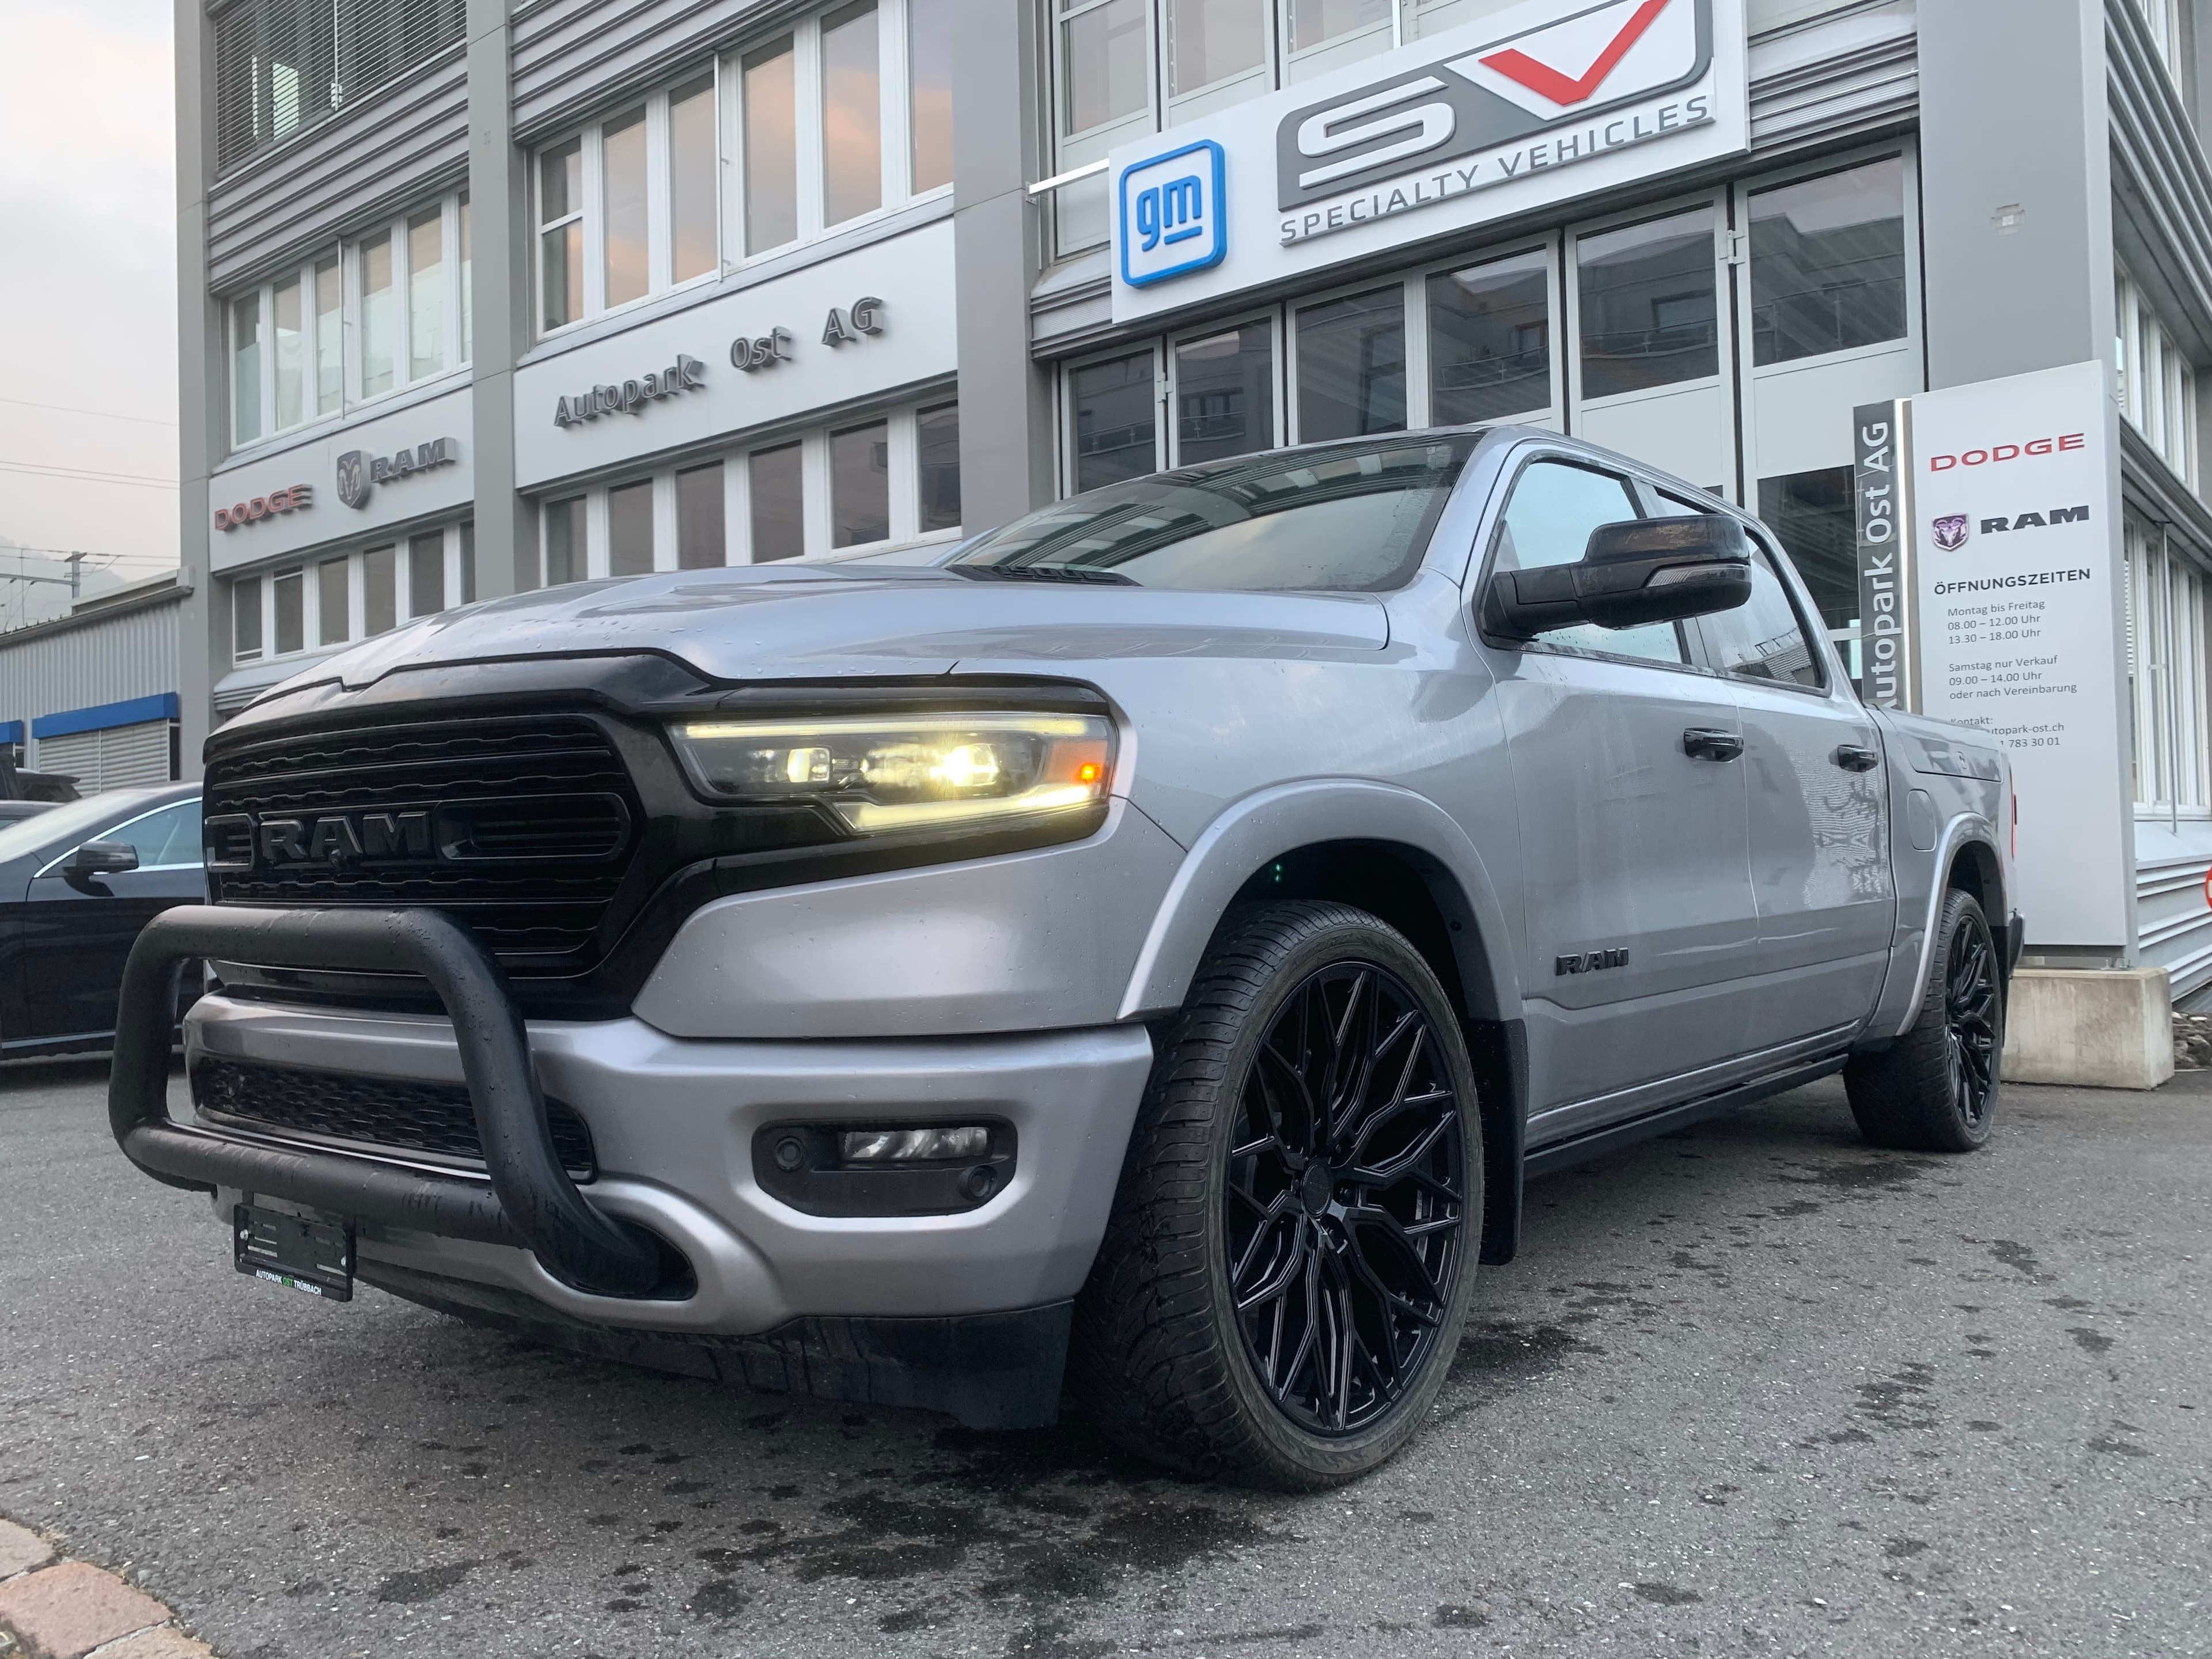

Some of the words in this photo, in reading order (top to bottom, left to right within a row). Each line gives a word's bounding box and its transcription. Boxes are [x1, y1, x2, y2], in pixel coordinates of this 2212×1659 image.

[1281, 164, 1479, 243] SPECIALTY
[1498, 95, 1709, 177] VEHICLES
[1137, 174, 1203, 252] gm
[554, 354, 703, 427] Autopark
[730, 325, 791, 372] Ost
[822, 296, 883, 347] AG
[370, 437, 455, 484] RAM
[1862, 421, 1891, 472] AG
[1931, 433, 2085, 472] DODGE
[214, 484, 312, 531] DODGE
[1865, 484, 1893, 543] Ost
[1980, 505, 2089, 535] RAM
[1934, 568, 2090, 594] ÖFFNUNGSZEITEN
[1948, 605, 1988, 616] Montag
[1991, 604, 2005, 612] bis
[2008, 601, 2045, 611] Freitag
[1948, 620, 1977, 630] 08.00
[1989, 616, 2018, 627] 12.00
[2021, 615, 2041, 623] Uhr
[1949, 634, 1977, 644] 13.30
[1990, 630, 2018, 641] 18.00
[2021, 628, 2041, 638] Uhr
[1949, 662, 1992, 672] Samstag
[1995, 661, 2013, 669] nur
[2016, 655, 2058, 666] Verkauf
[1949, 676, 1978, 685] 09.00
[1991, 673, 2020, 683] 14.00
[2022, 672, 2042, 680] Uhr
[1950, 691, 1974, 699] oder
[1976, 688, 2001, 698] nach
[2003, 684, 2077, 696] Vereinbarung
[2009, 739, 2028, 748] 783
[2031, 738, 2044, 747] 30
[2047, 737, 2061, 745] 01
[261, 812, 430, 859] RAM
[1555, 947, 1628, 976] RAM
[256, 1269, 282, 1284] AUTOPARK
[283, 1277, 293, 1286] OST
[294, 1280, 322, 1295] TRÜBBACH
